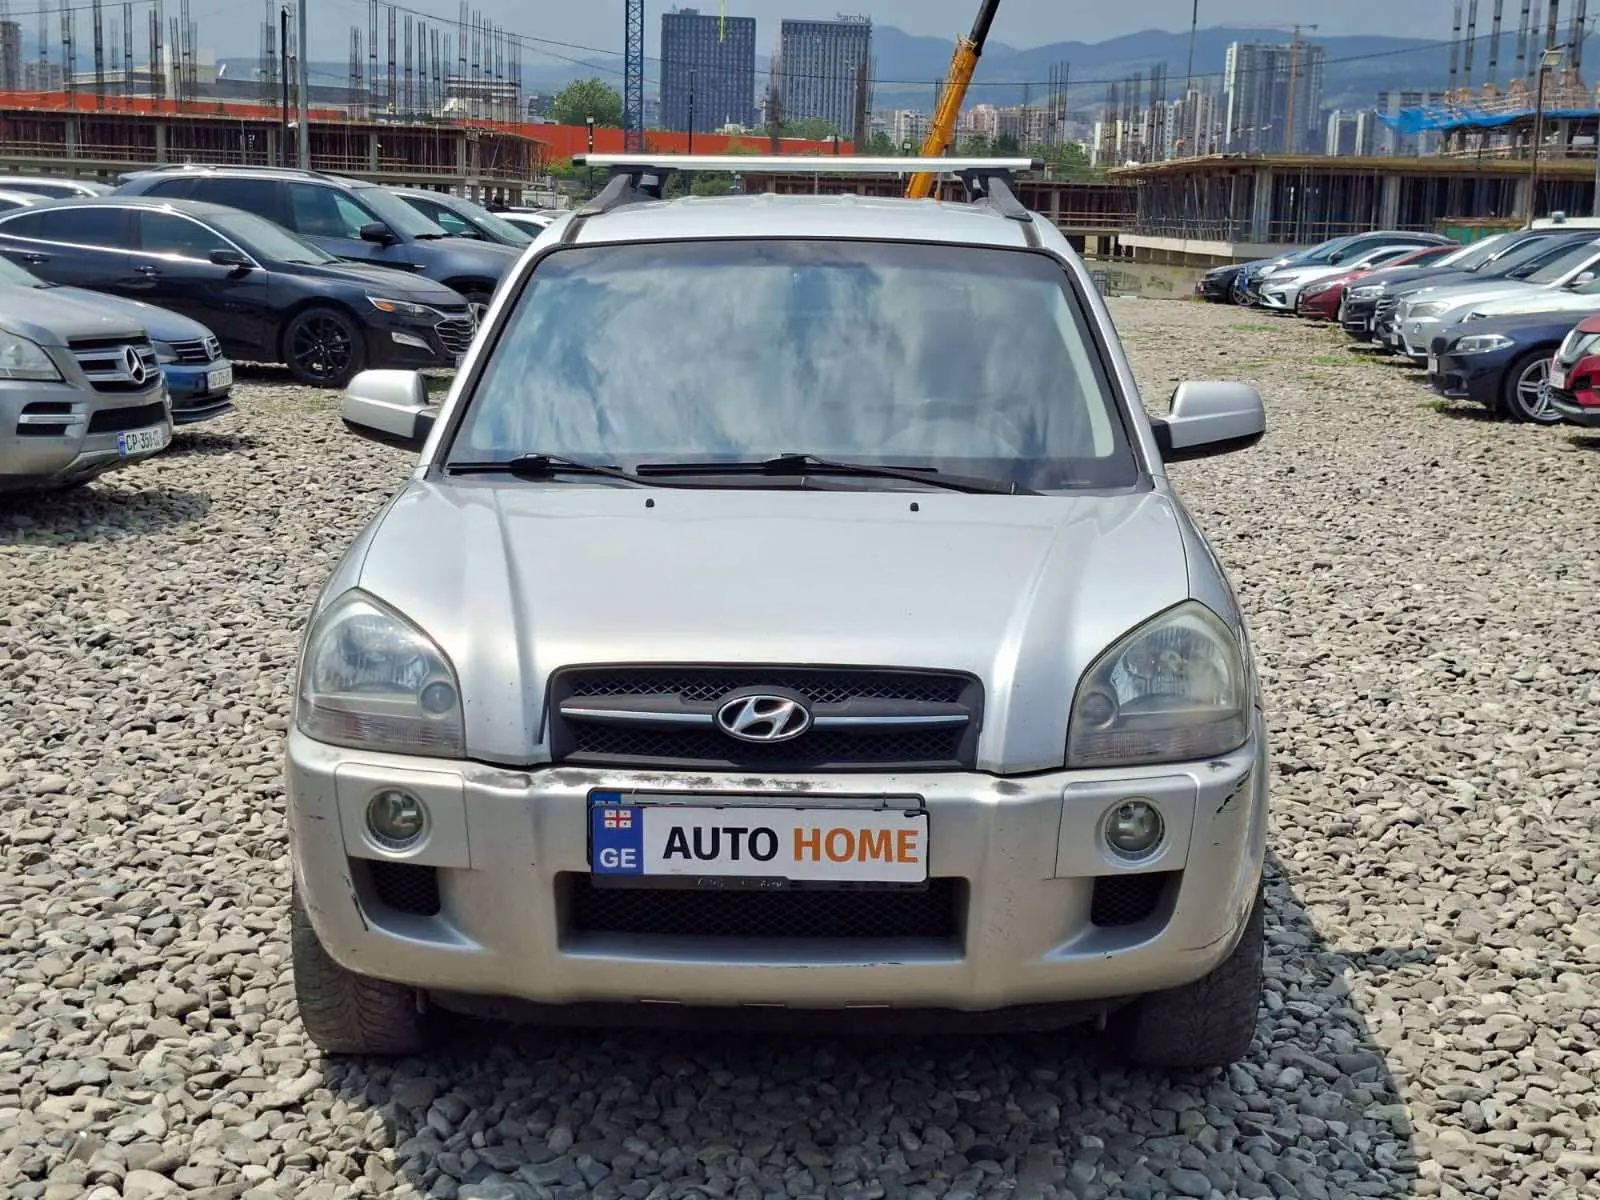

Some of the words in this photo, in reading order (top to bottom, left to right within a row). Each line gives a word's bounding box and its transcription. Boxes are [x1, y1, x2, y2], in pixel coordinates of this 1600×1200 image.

[599, 847, 637, 869] GE
[662, 826, 779, 862] AUTO
[792, 828, 919, 865] HOME
